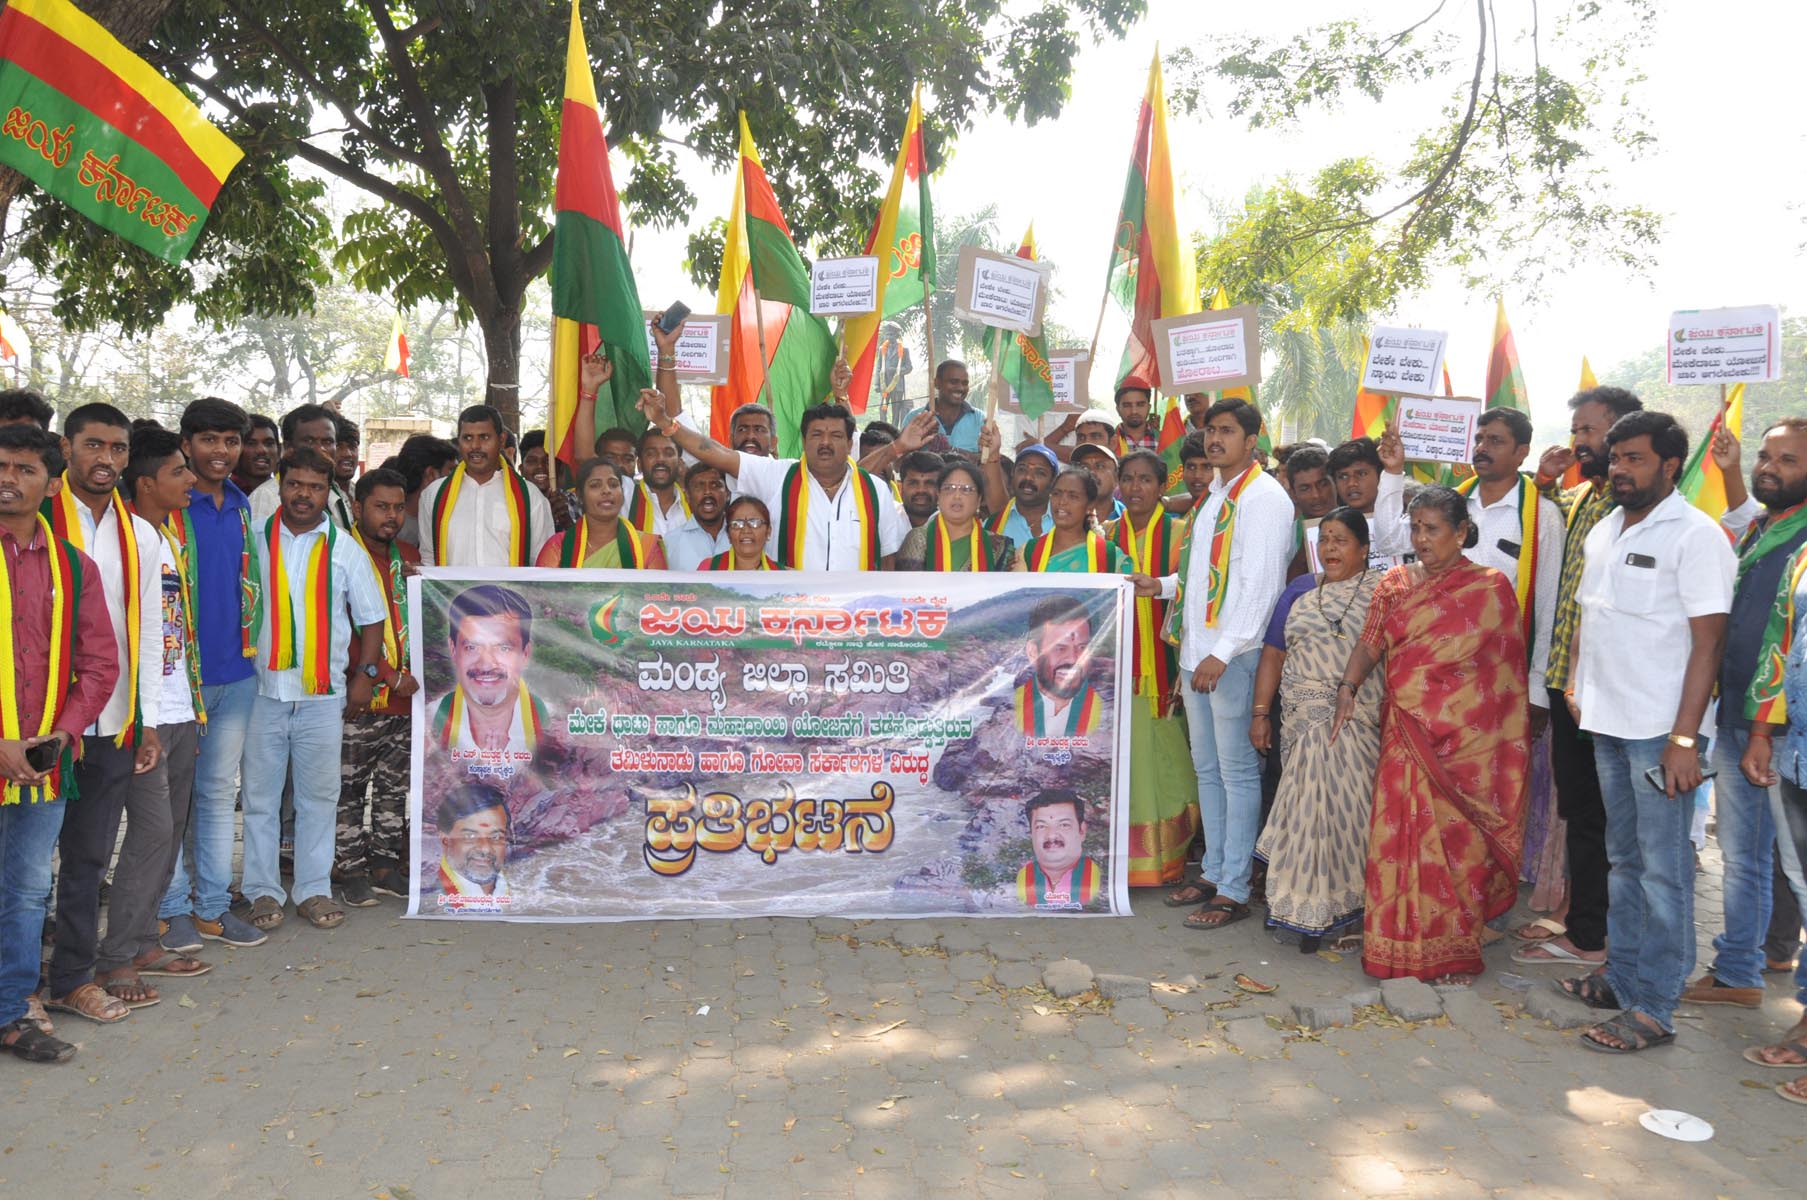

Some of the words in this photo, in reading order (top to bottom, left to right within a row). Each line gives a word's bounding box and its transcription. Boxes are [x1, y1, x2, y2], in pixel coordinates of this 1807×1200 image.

[2, 106, 75, 168] ಜಯ
[78, 149, 197, 237] ಕರ್ನಾಟಕ
[1372, 353, 1396, 366] ಬೇಕೇ
[1673, 347, 1697, 356] ಬೇಕೇ
[1371, 369, 1397, 384] ನ್ಯಾಯ
[1401, 370, 1426, 382] ಬೇಕು
[641, 603, 745, 637] ಜಯ
[759, 606, 948, 645] ಕರ್ನಾಟಕ
[649, 639, 673, 647] JAYA
[676, 639, 735, 647] KARNATAKA
[638, 651, 727, 710] ಮಂಡ್ಯ
[742, 660, 810, 706] ಜಿಲ್ಲಾ
[823, 654, 911, 694] ಸಮಿತಿ
[568, 707, 607, 735] ಮೇಕೆ
[655, 709, 702, 736] ಹಾಗೂ
[707, 710, 787, 737] ಮಹಾದಾಯಿ
[792, 711, 864, 738] ಯೋಜನೆಗೆ
[611, 744, 694, 772] ತಮಿಳುನಾಡು
[699, 746, 746, 773] ಹಾಗೂ
[750, 745, 803, 773] ಗೋವಾ
[809, 746, 884, 774] ಸರ್ಕಾರಗಳ
[890, 750, 930, 785] ವಿರುದ್ಧ
[644, 781, 897, 877] ಪ್ರತಿಭಟನೆ
